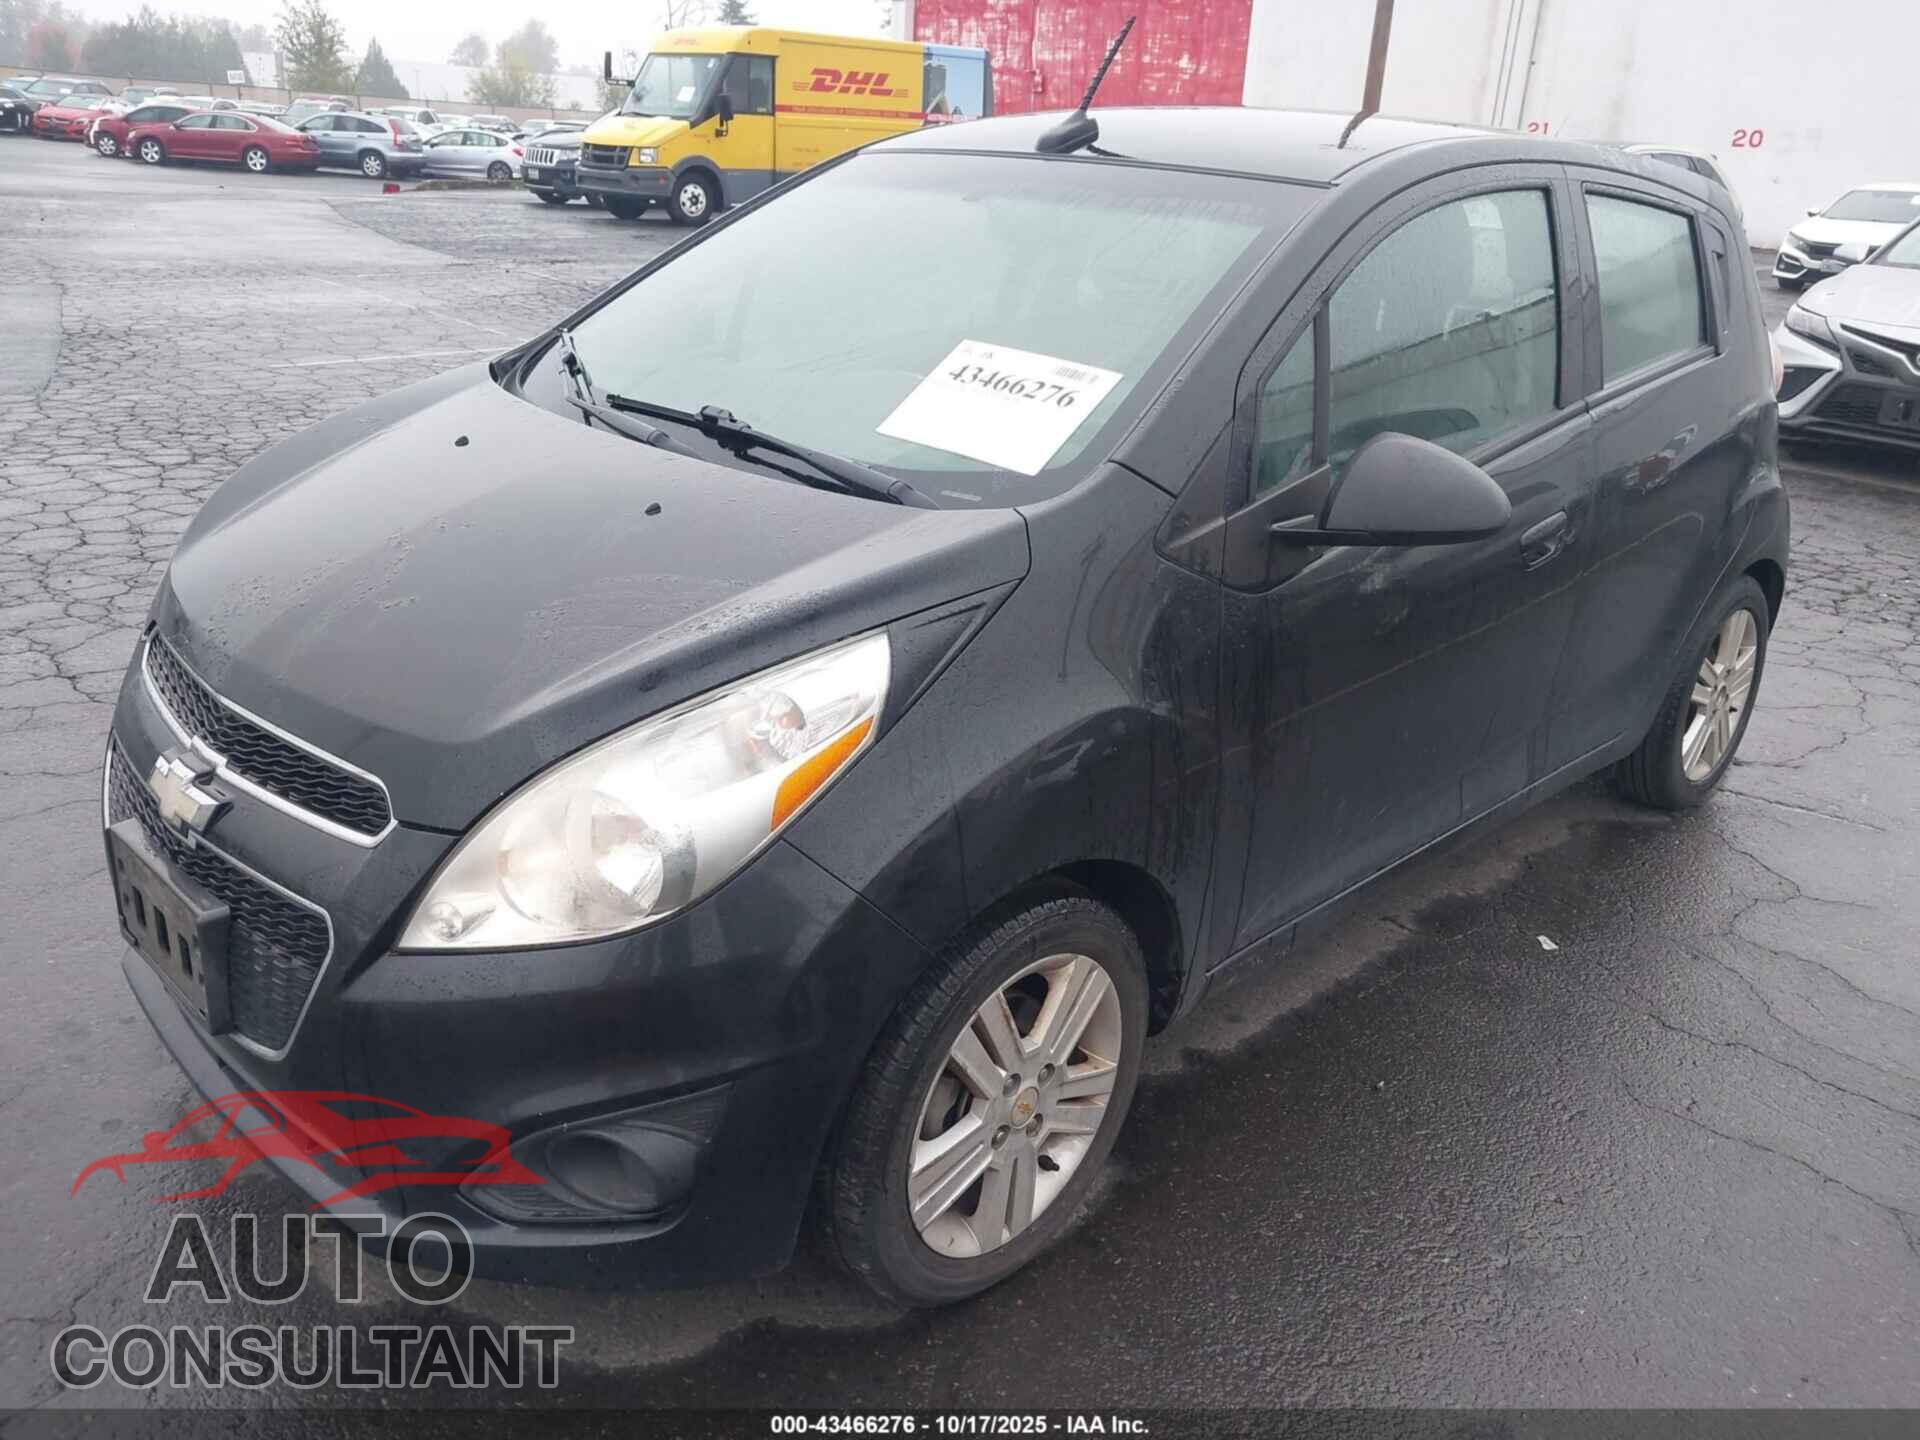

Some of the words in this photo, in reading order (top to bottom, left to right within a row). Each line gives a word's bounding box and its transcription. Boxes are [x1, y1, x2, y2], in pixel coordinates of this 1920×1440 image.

[810, 67, 893, 96] DHL
[1732, 129, 1764, 148] 20
[949, 364, 1080, 408] 43466276
